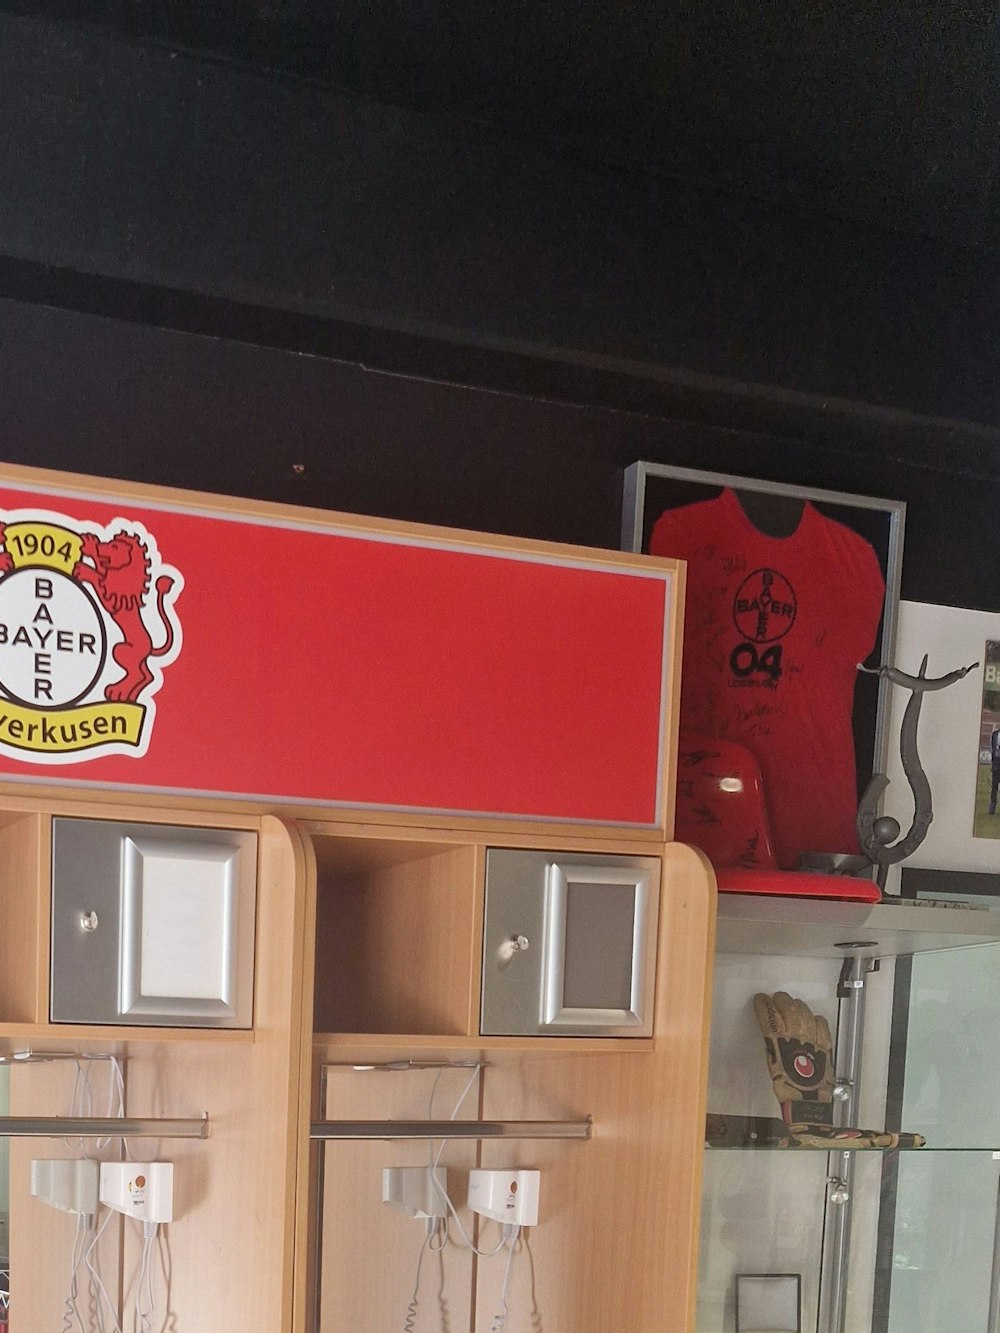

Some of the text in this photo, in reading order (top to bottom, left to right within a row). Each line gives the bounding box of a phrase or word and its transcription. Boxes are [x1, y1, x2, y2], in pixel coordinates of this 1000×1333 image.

[11, 533, 73, 563] 1904
[736, 598, 794, 618] BAYER
[33, 577, 54, 700] BAYER
[729, 642, 783, 681] 04
